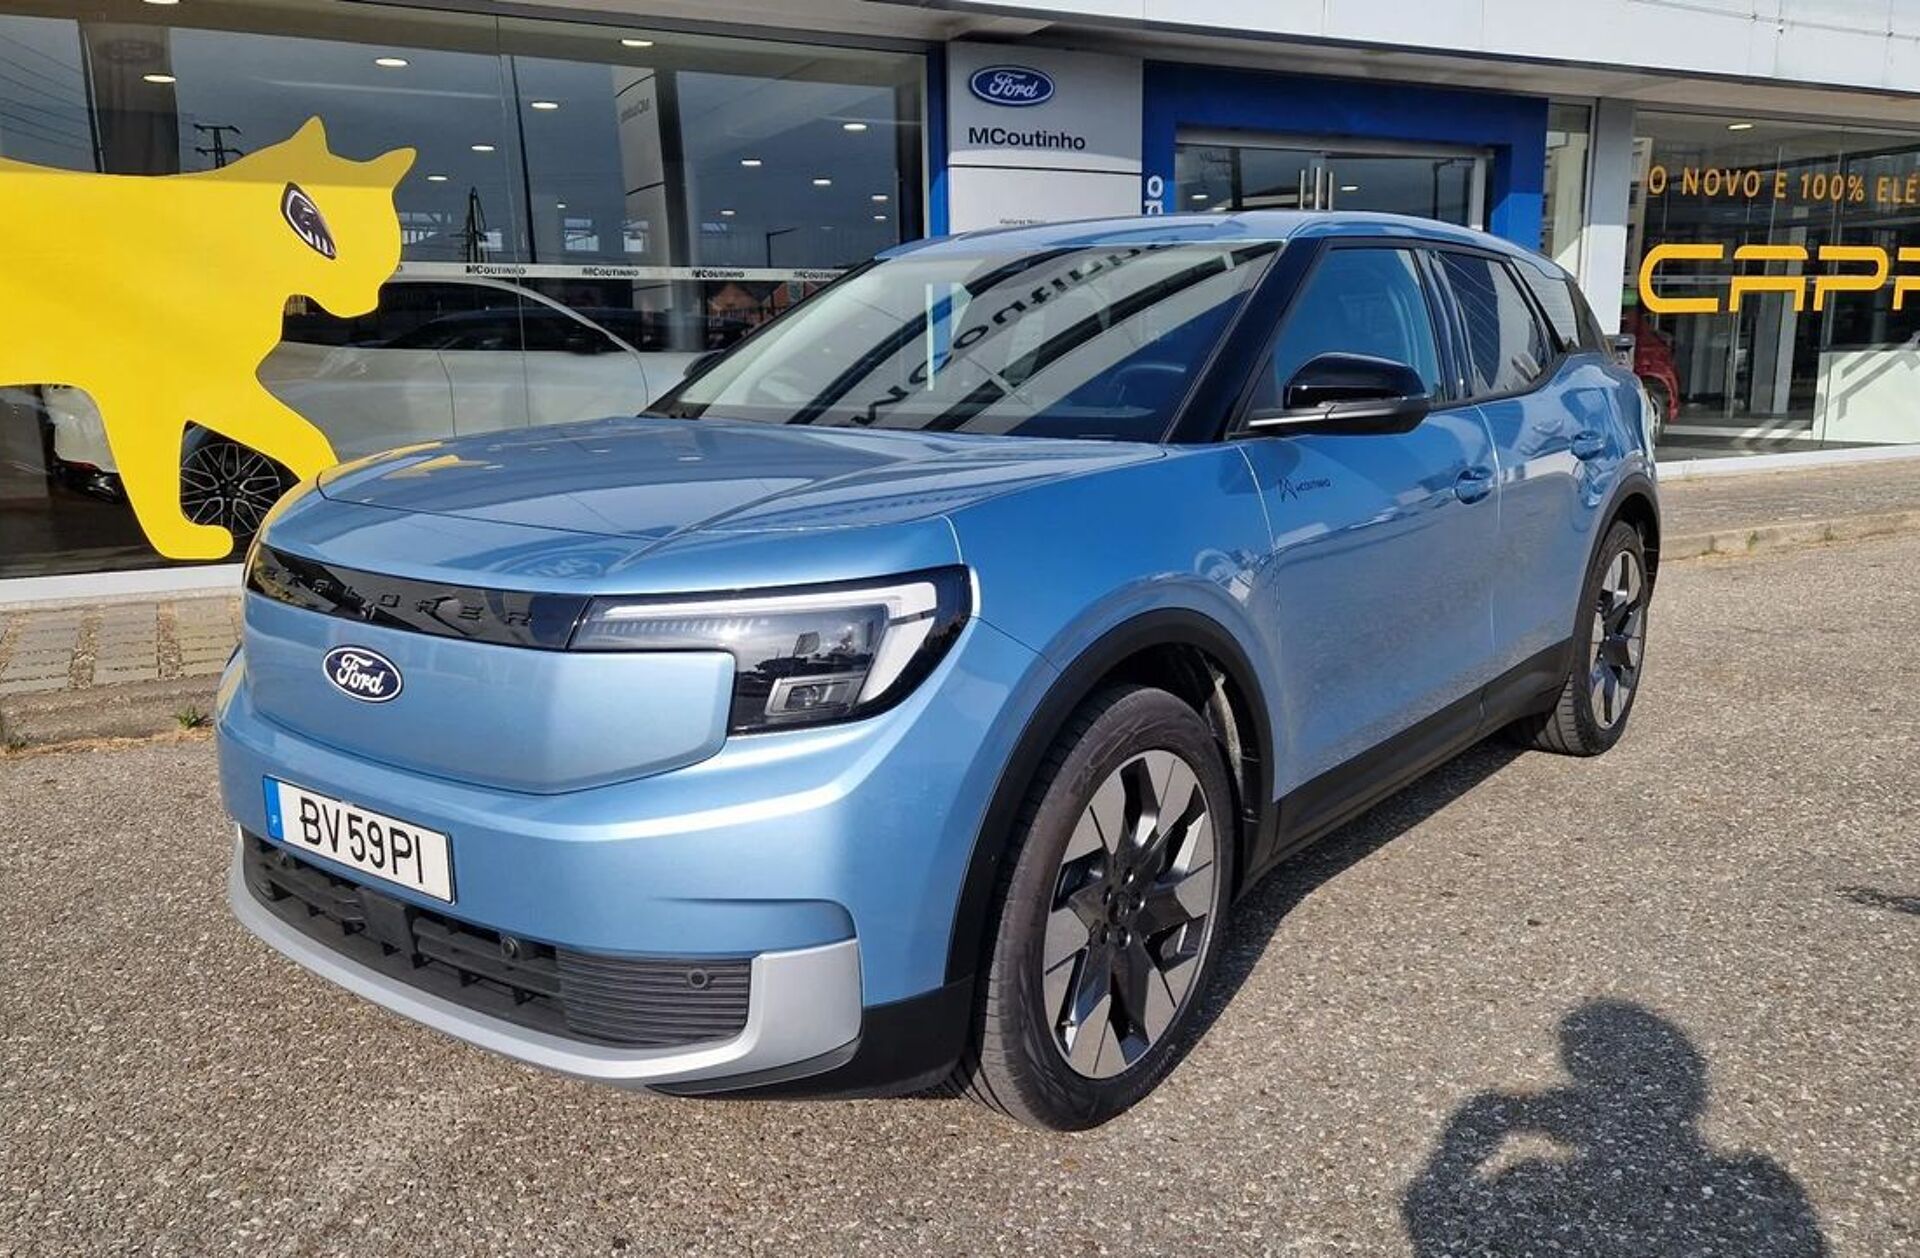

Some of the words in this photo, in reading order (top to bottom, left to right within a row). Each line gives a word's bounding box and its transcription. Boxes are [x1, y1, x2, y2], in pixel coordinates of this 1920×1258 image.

[989, 71, 1039, 98] Ford
[968, 126, 1086, 150] MCoutinho
[1650, 165, 1666, 194] O
[1682, 167, 1760, 198] NOVO
[1774, 173, 1788, 199] E
[1801, 172, 1864, 202] 100%
[336, 653, 386, 696] Ford
